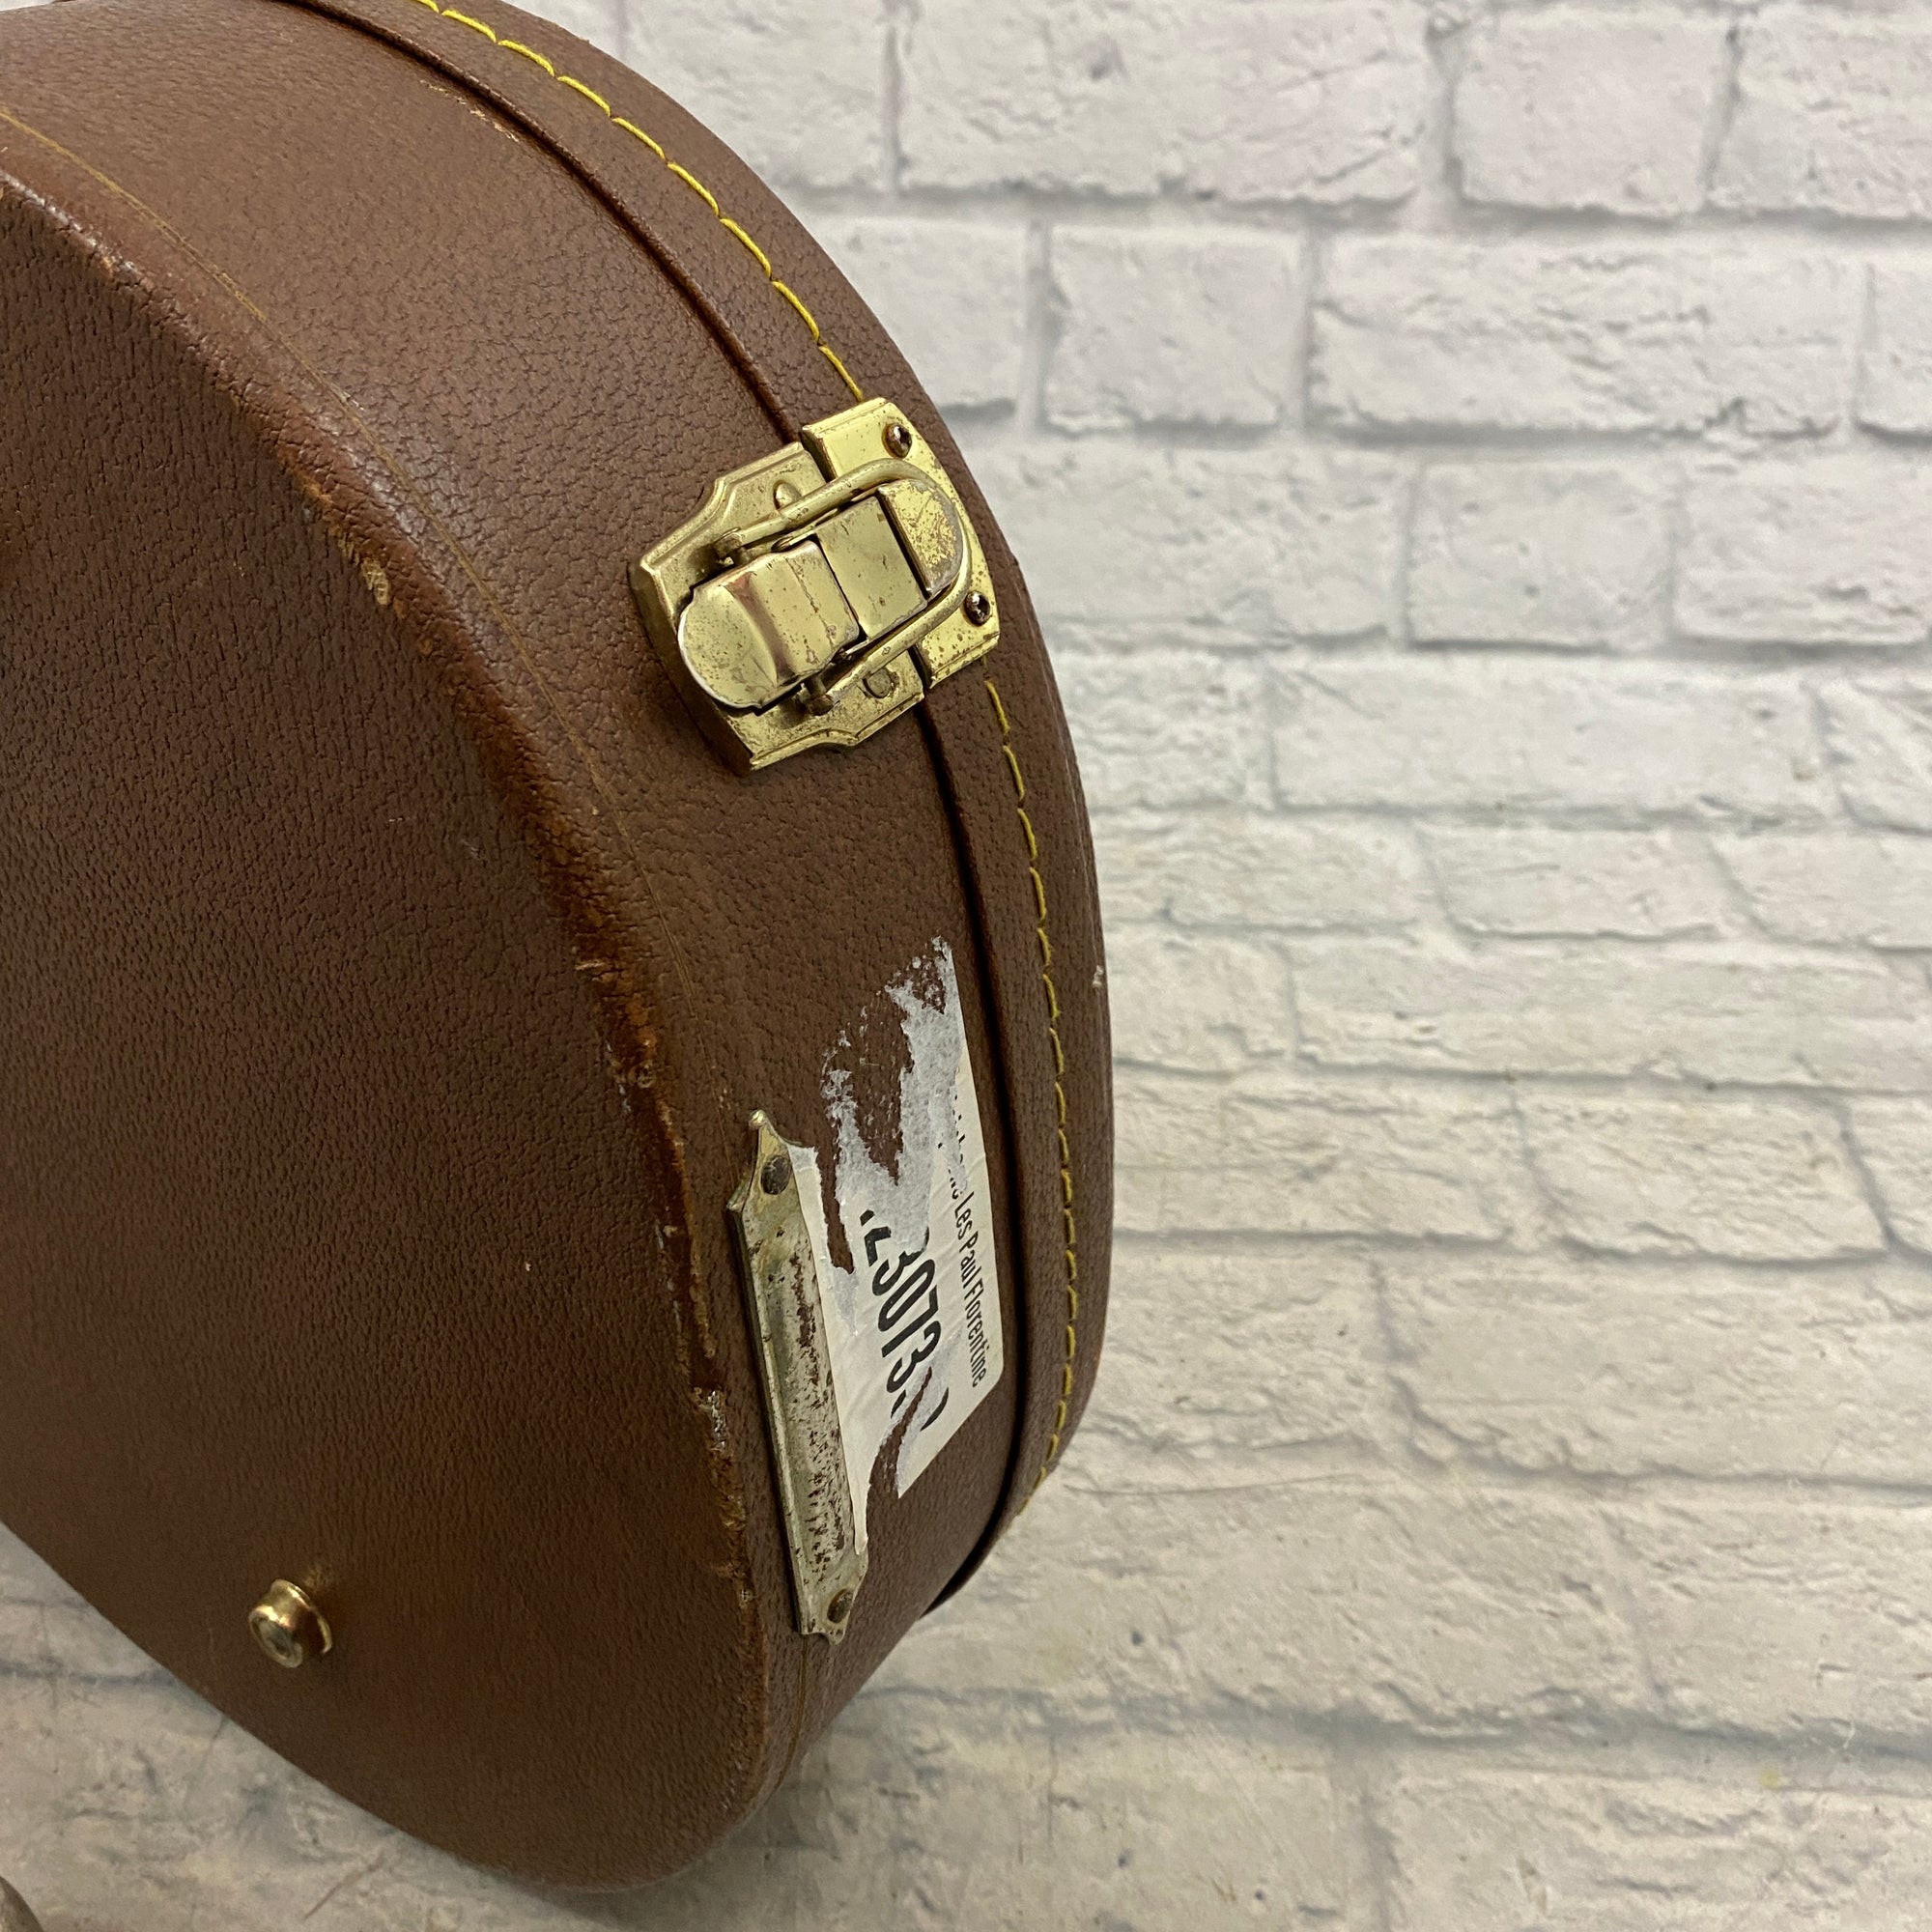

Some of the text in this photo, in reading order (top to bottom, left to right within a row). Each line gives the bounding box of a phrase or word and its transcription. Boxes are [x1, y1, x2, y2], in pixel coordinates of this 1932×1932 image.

[954, 1190, 990, 1388] Les Paul Florentine
